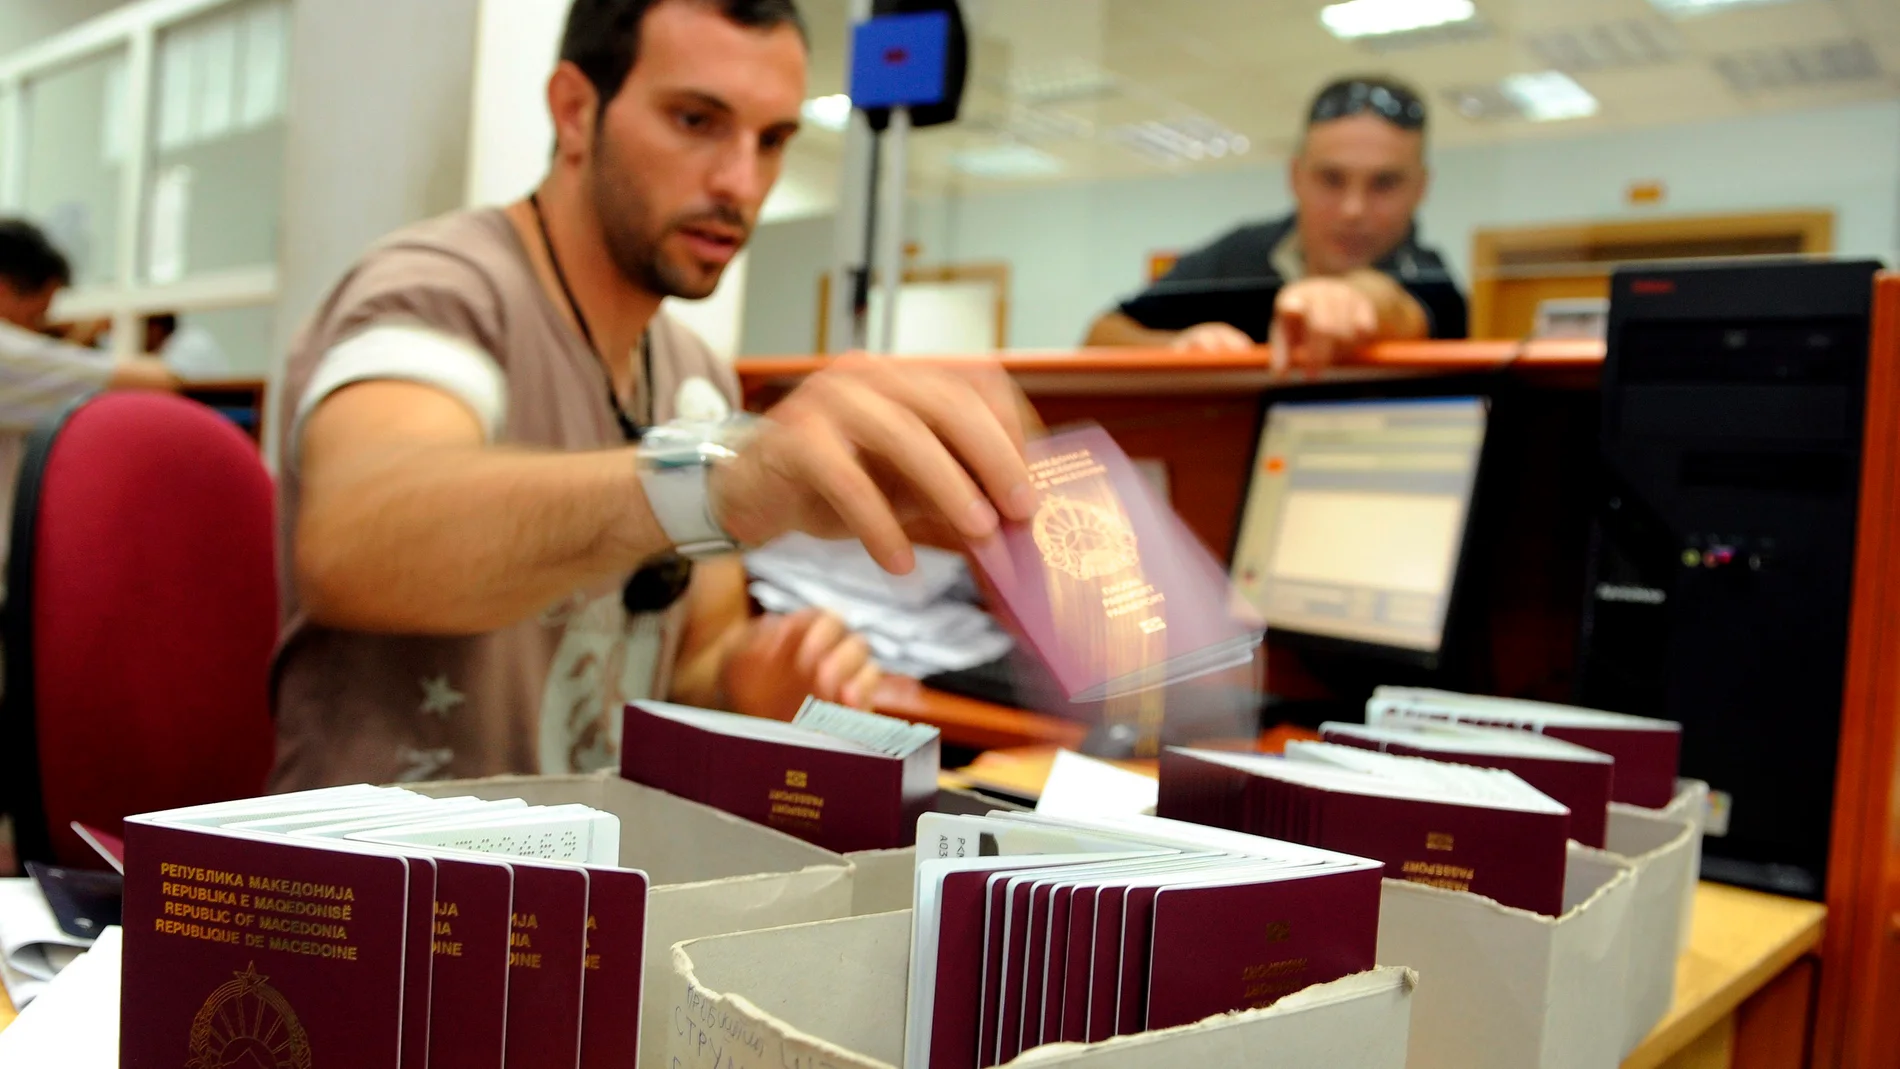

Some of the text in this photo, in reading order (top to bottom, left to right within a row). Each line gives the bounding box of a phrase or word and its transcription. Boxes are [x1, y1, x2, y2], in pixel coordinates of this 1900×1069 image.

[161, 862, 355, 901] РЕПУБЛИКА МАКЕДОНИЈА
[162, 881, 352, 921] REPUBLIKA E MAQEDONISË
[155, 918, 358, 961] REPUBLIQUE DE MACEDOINE
[164, 901, 348, 940] REPUBLIC OF MACEDONIA
